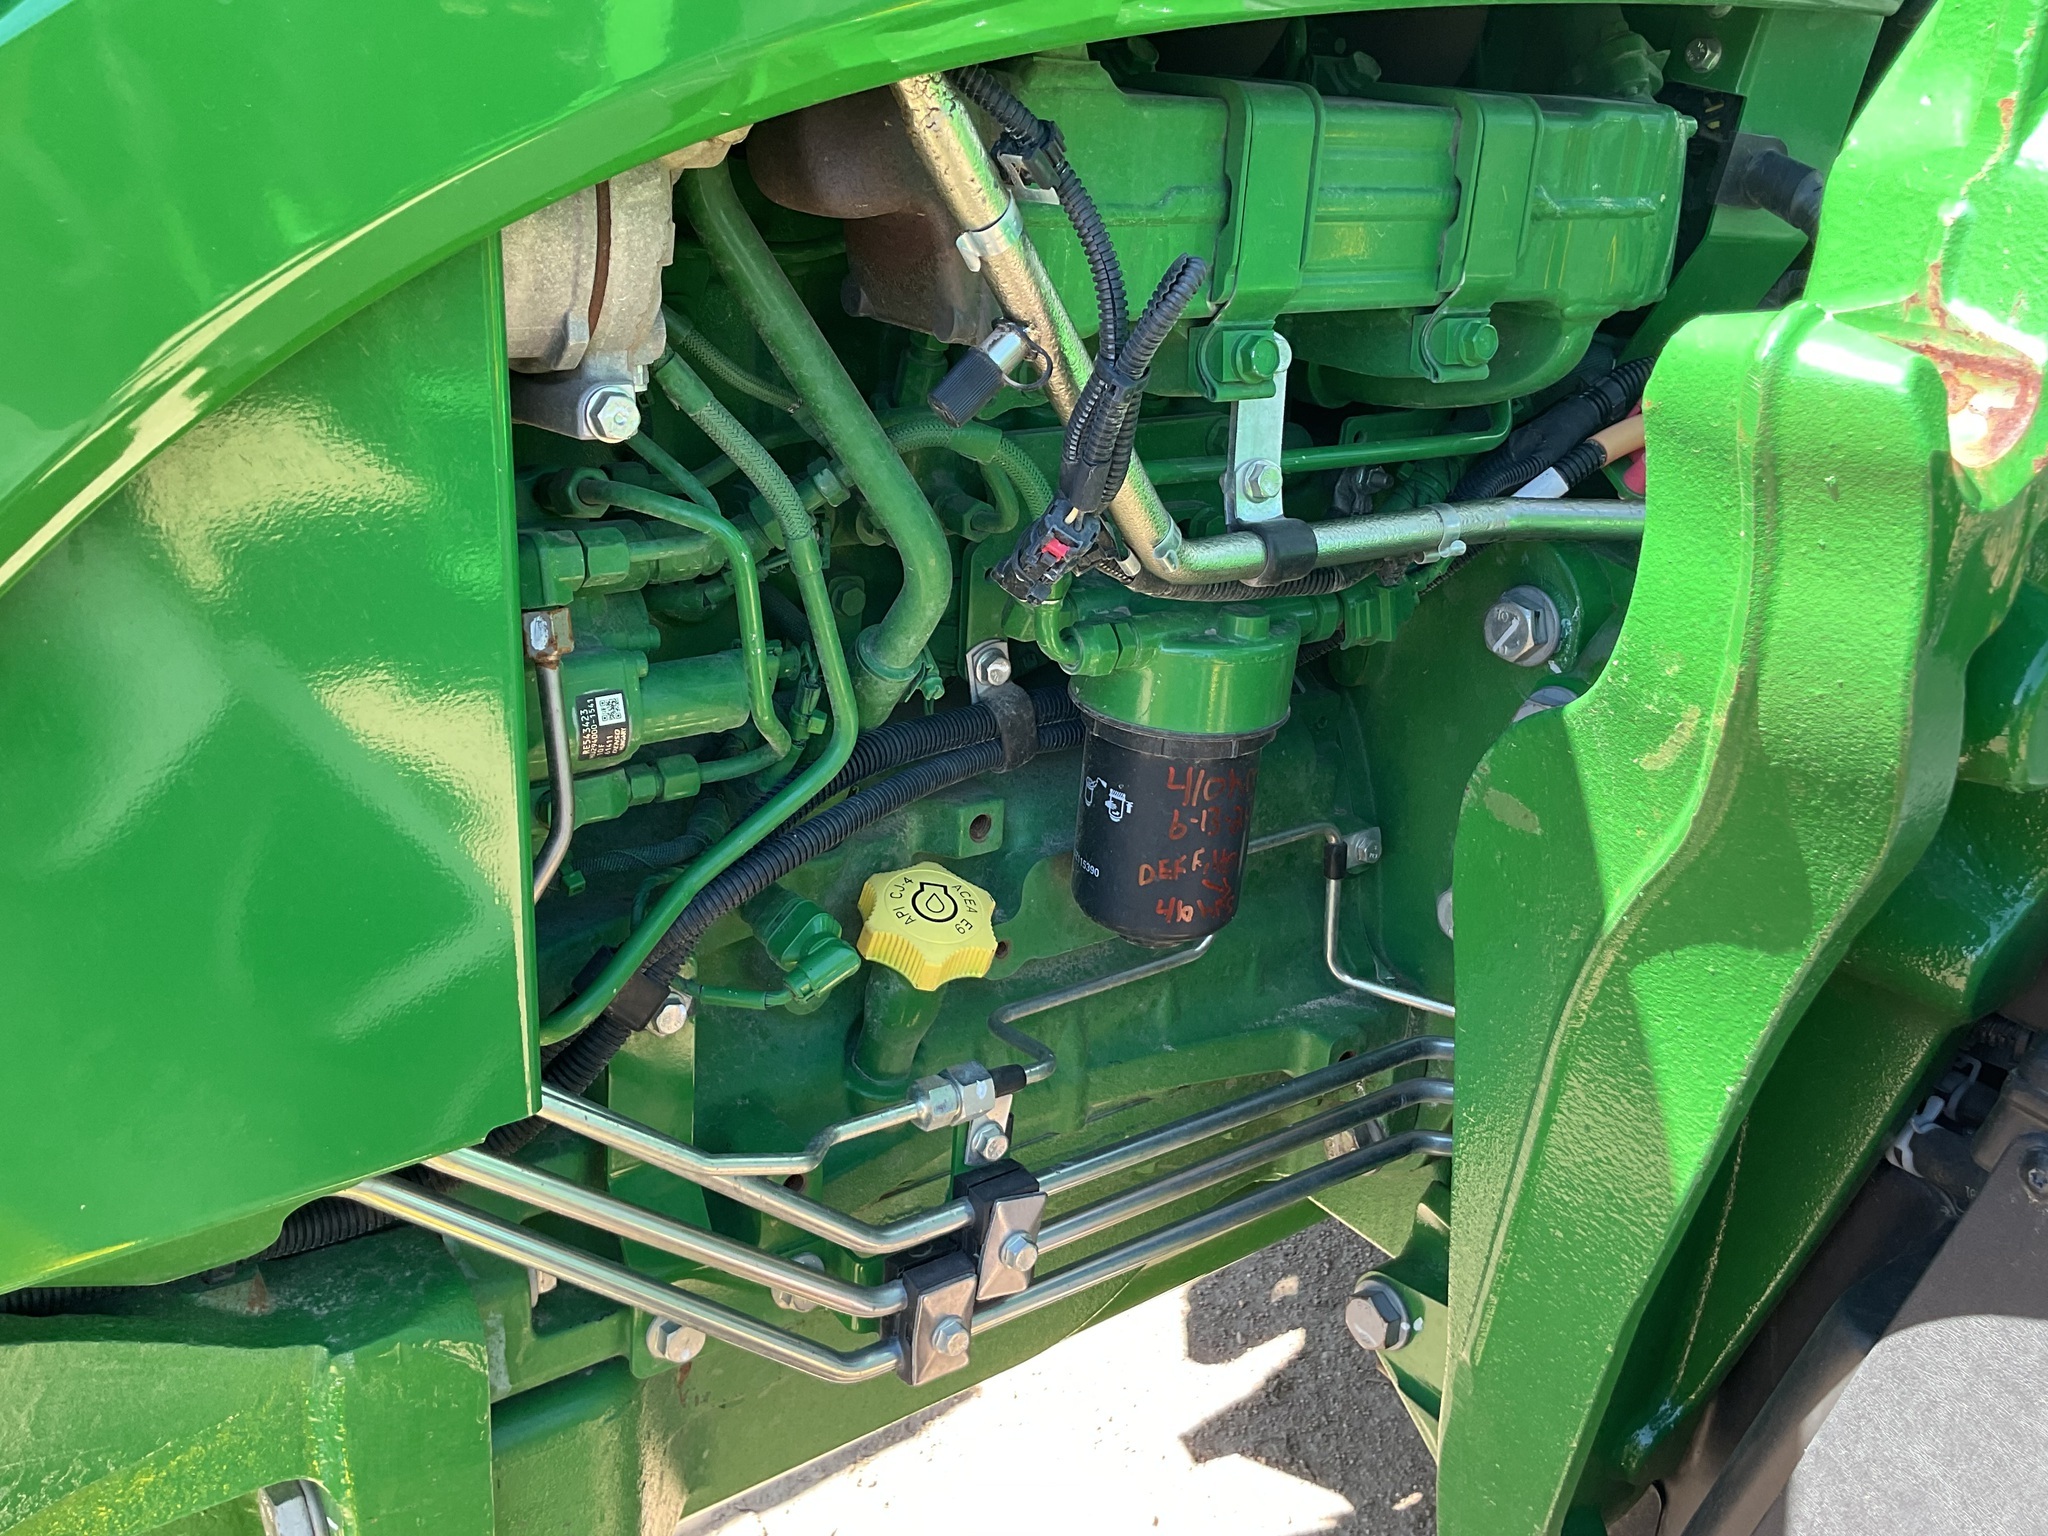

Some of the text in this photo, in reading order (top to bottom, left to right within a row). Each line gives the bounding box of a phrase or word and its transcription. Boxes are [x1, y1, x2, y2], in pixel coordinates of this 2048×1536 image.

[580, 709, 591, 755] RE543423
[612, 729, 621, 754] DENSO
[1138, 854, 1187, 886] DEF
[890, 877, 916, 926] API CJ-4
[951, 884, 978, 935] ACEA E9
